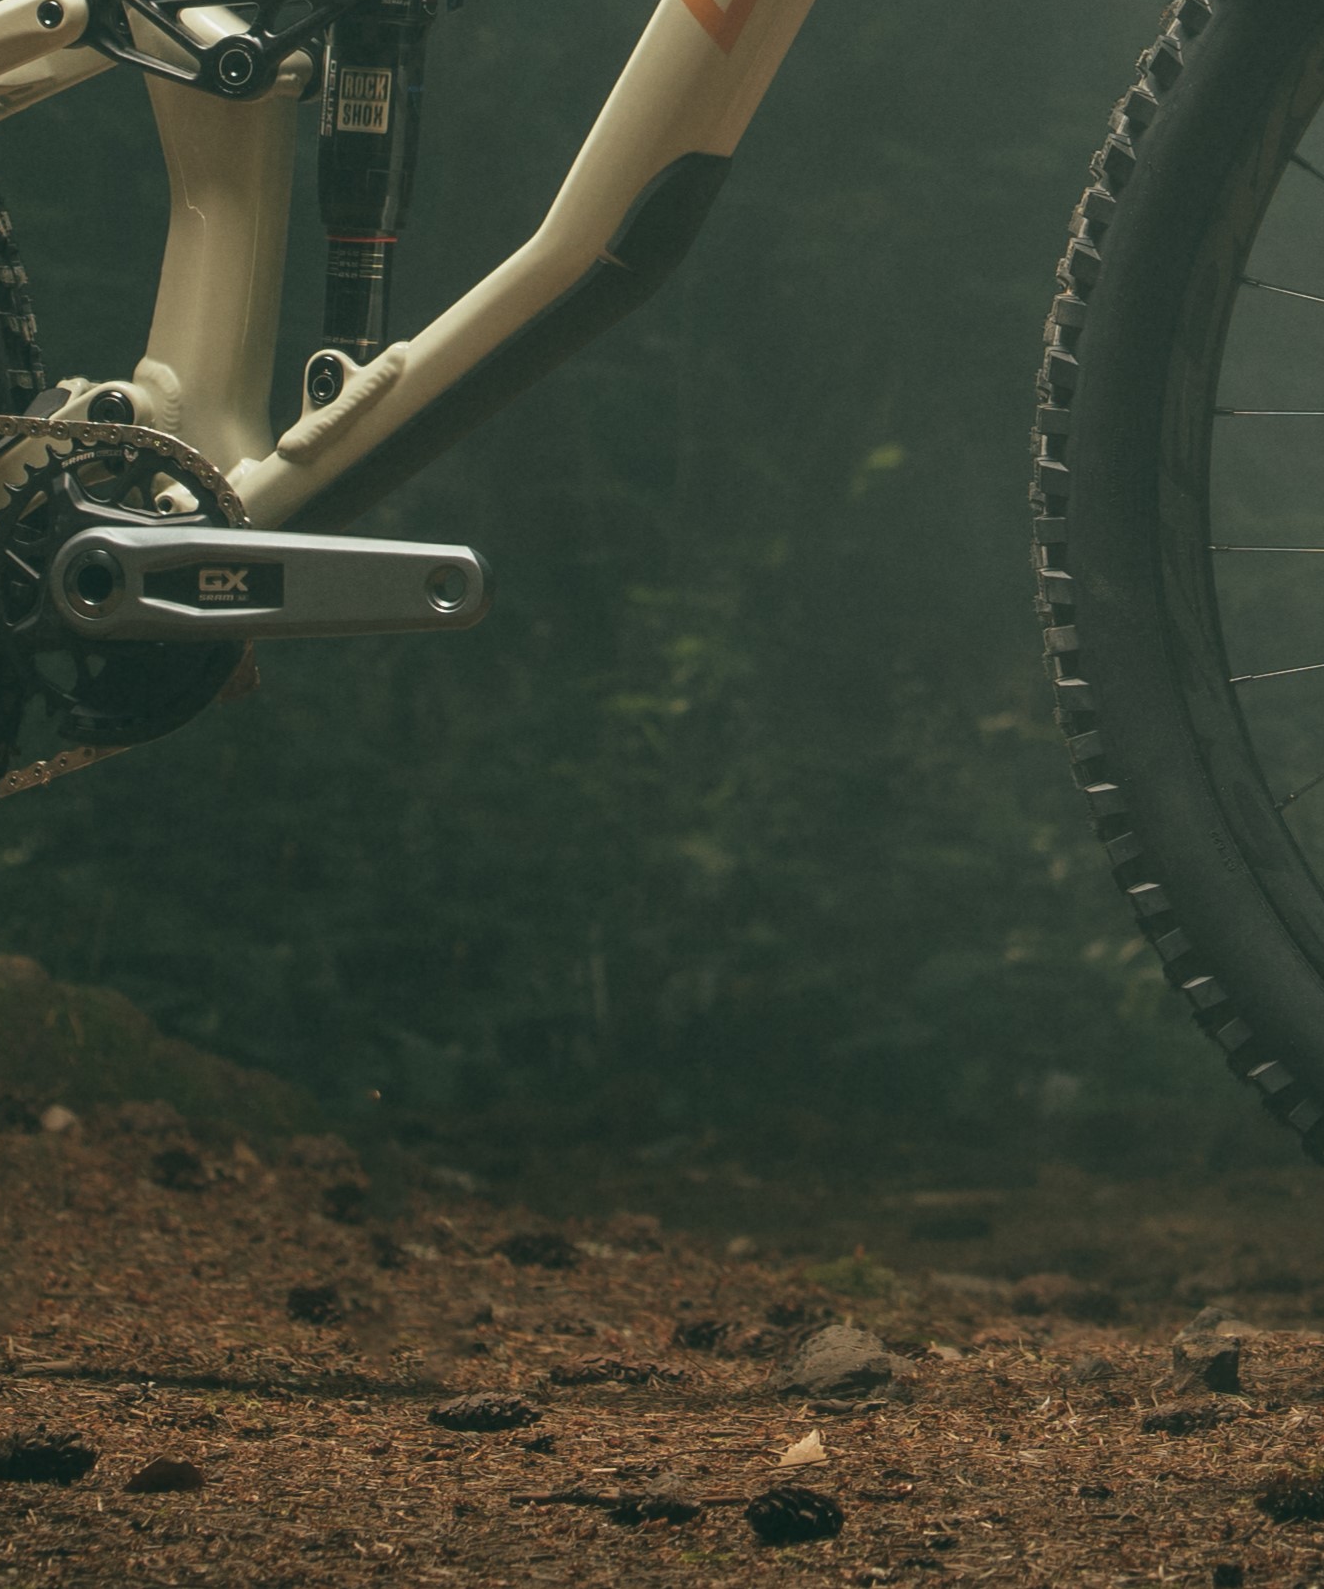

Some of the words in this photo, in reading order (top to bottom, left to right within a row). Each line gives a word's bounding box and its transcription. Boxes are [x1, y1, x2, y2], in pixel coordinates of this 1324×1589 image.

[324, 59, 337, 137] DELUXE
[344, 72, 388, 101] ROCK
[342, 103, 384, 128] SHOX
[198, 569, 249, 592] GX
[198, 594, 235, 602] SRAM
